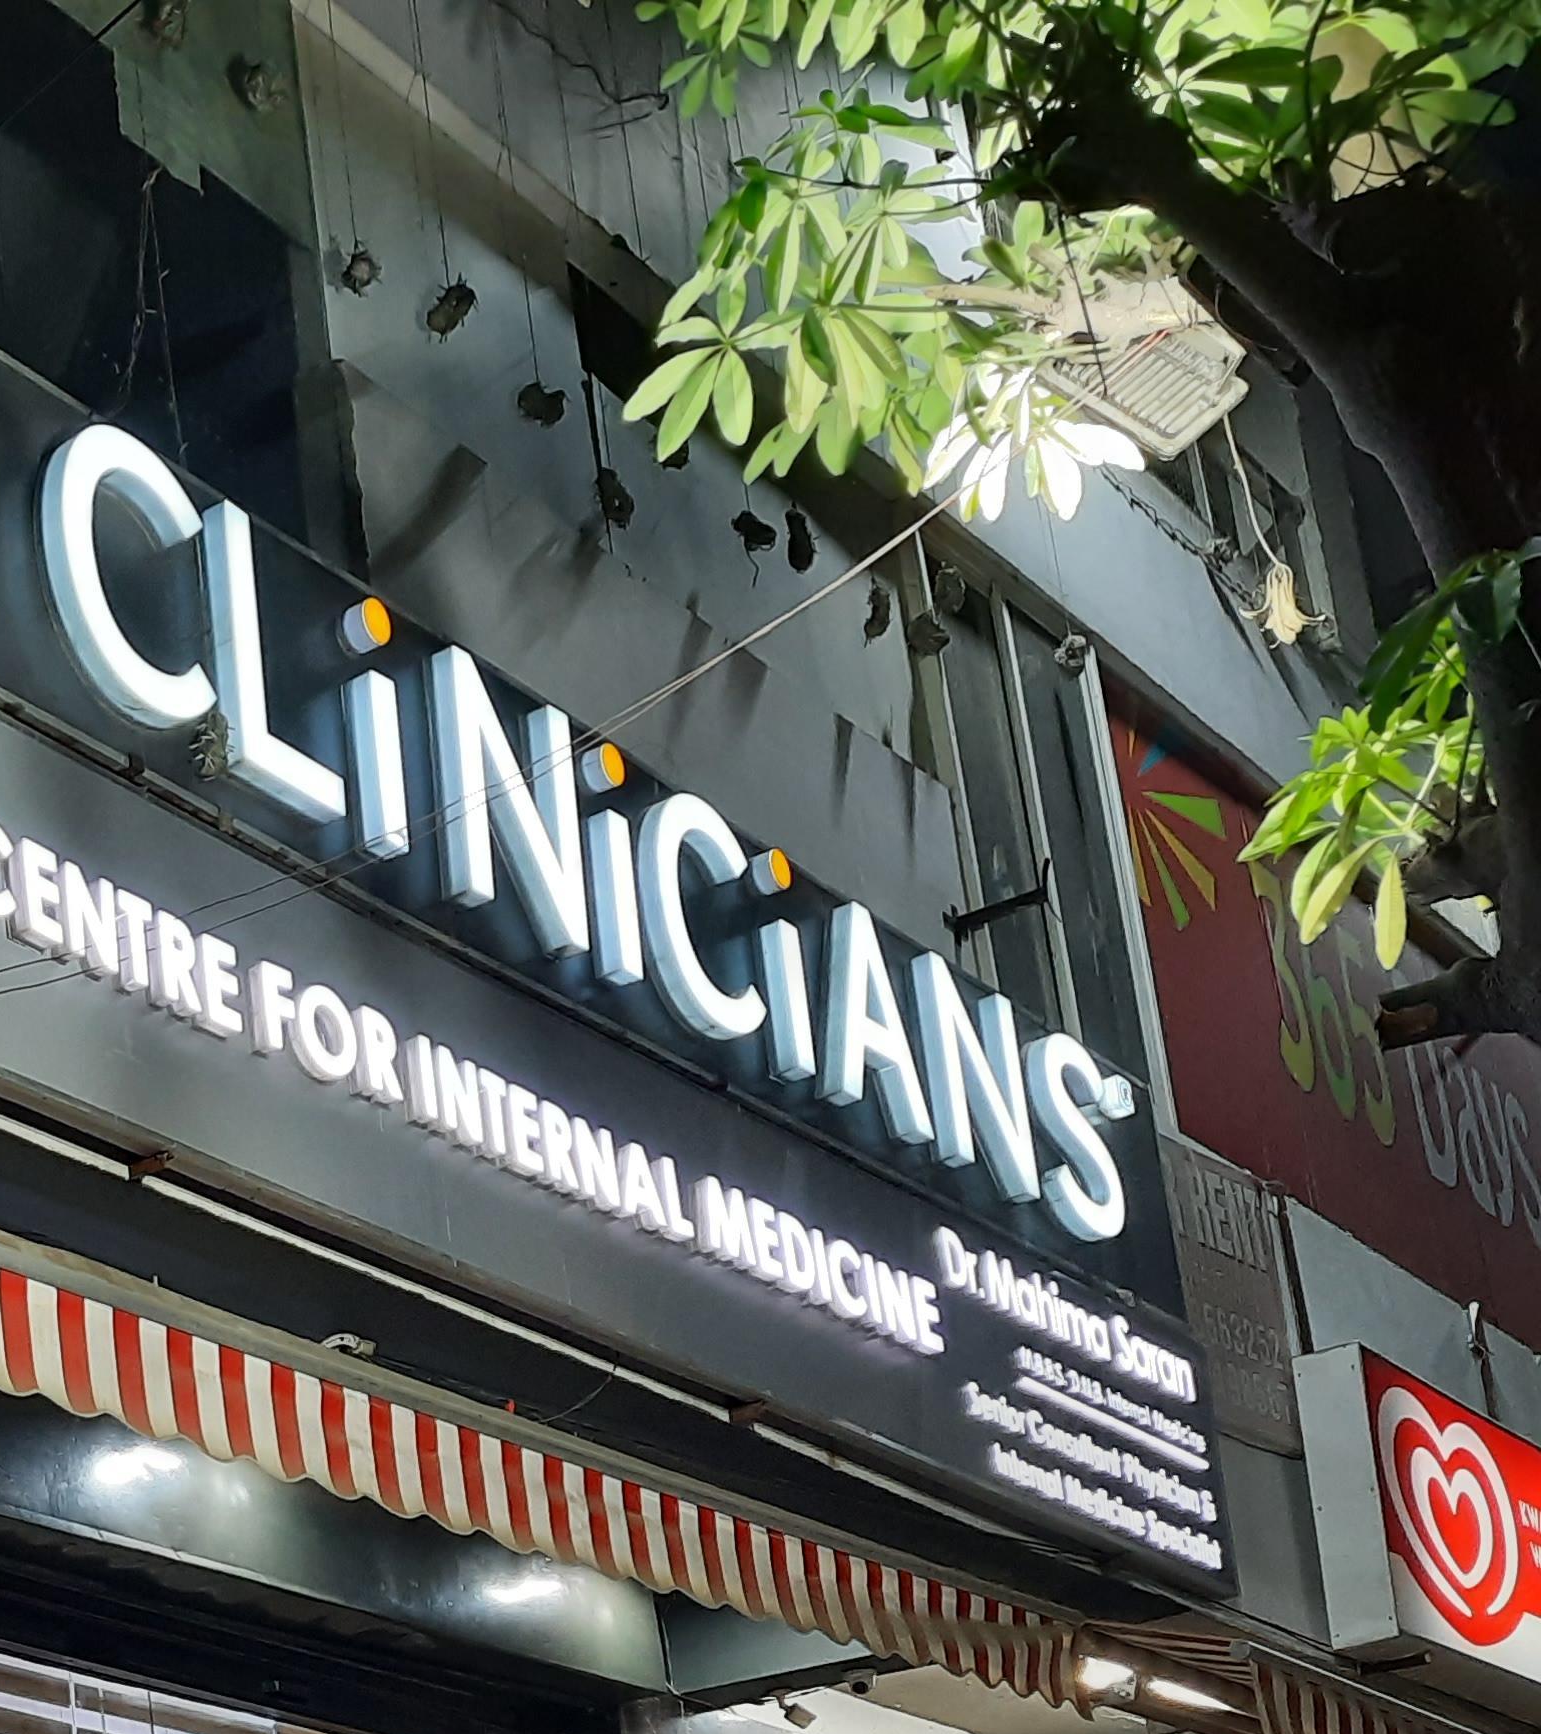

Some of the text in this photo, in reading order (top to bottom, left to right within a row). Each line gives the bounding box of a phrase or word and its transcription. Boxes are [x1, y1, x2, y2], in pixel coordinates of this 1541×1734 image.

[248, 960, 403, 1104] FOR
[404, 1033, 694, 1245] INTERNAL
[694, 1174, 946, 1357] MEDICINE
[1110, 1314, 1197, 1403] Saran
